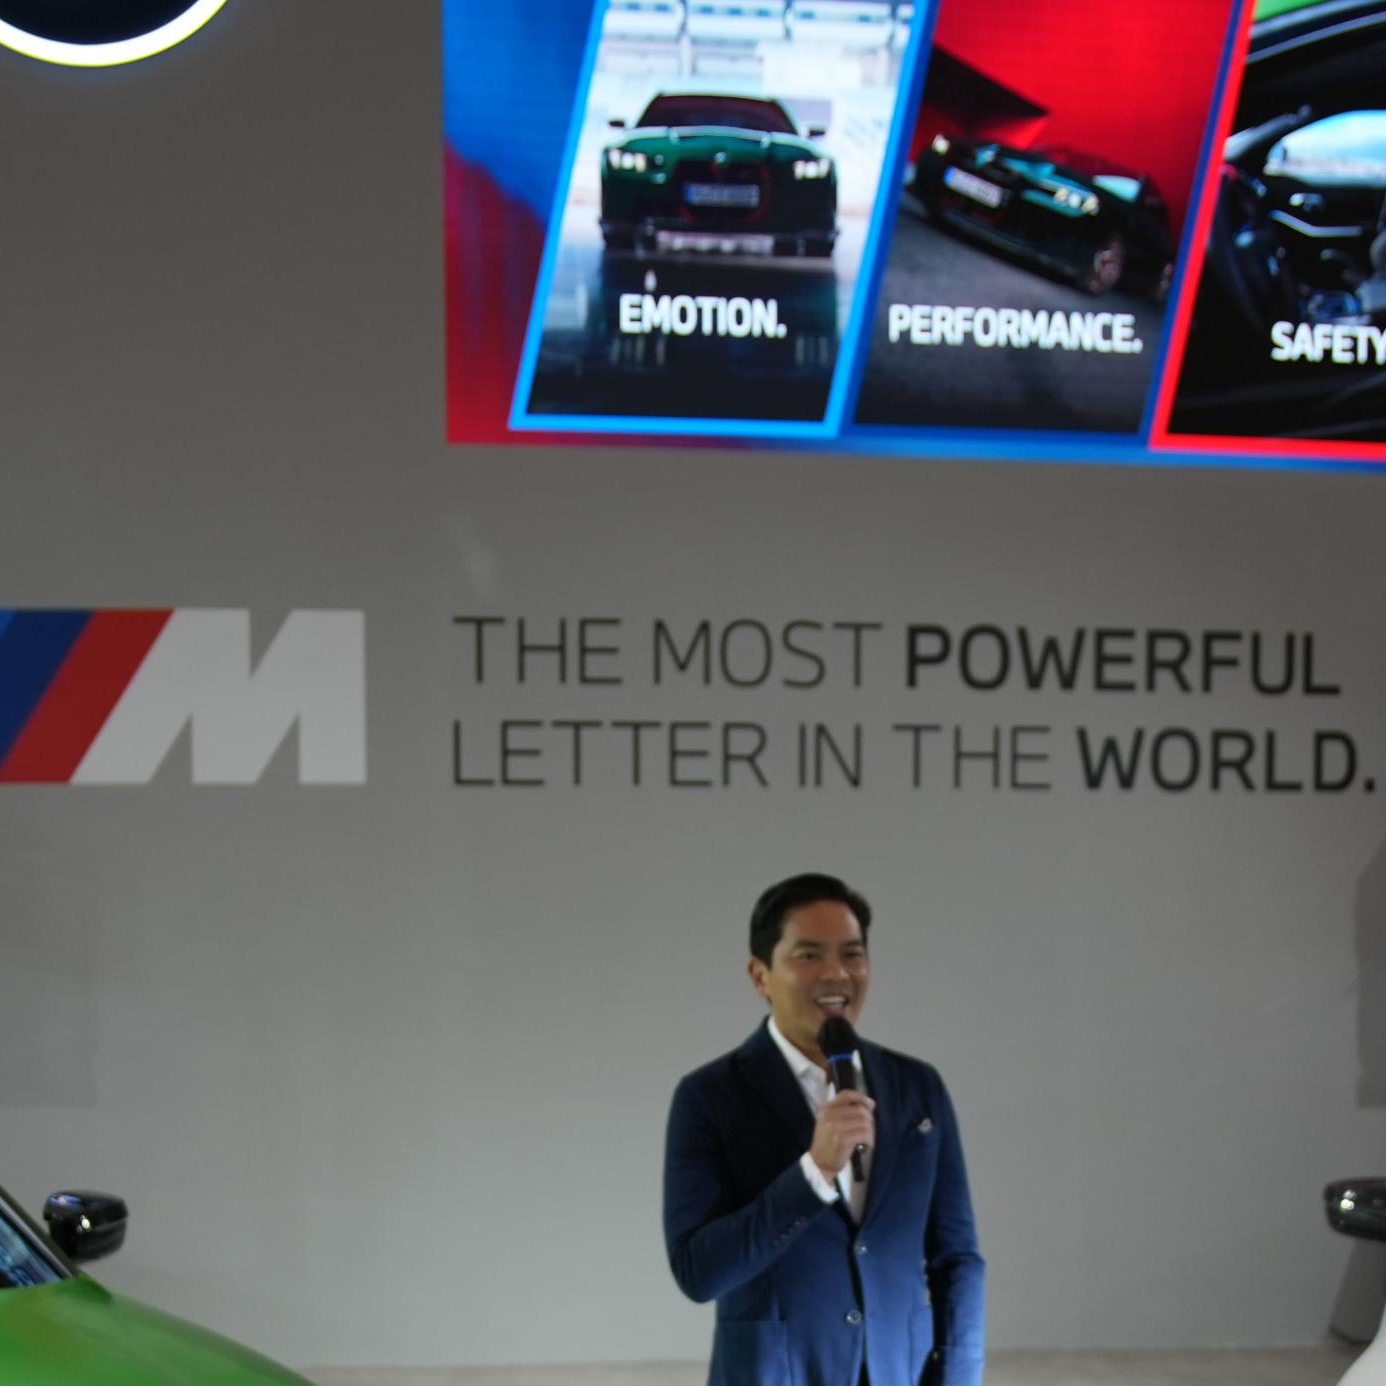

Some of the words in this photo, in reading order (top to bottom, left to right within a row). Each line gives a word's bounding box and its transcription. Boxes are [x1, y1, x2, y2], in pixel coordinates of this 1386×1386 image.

[619, 293, 787, 339] EMOTION.
[888, 303, 1143, 354] PERFORMANCE.
[453, 616, 623, 686] THE
[653, 618, 883, 690] MOST
[905, 623, 1343, 696] POWERFUL
[453, 719, 769, 788] LETTER
[799, 722, 863, 789] IN
[892, 723, 1051, 791] THE
[1075, 727, 1377, 794] WORLD.
